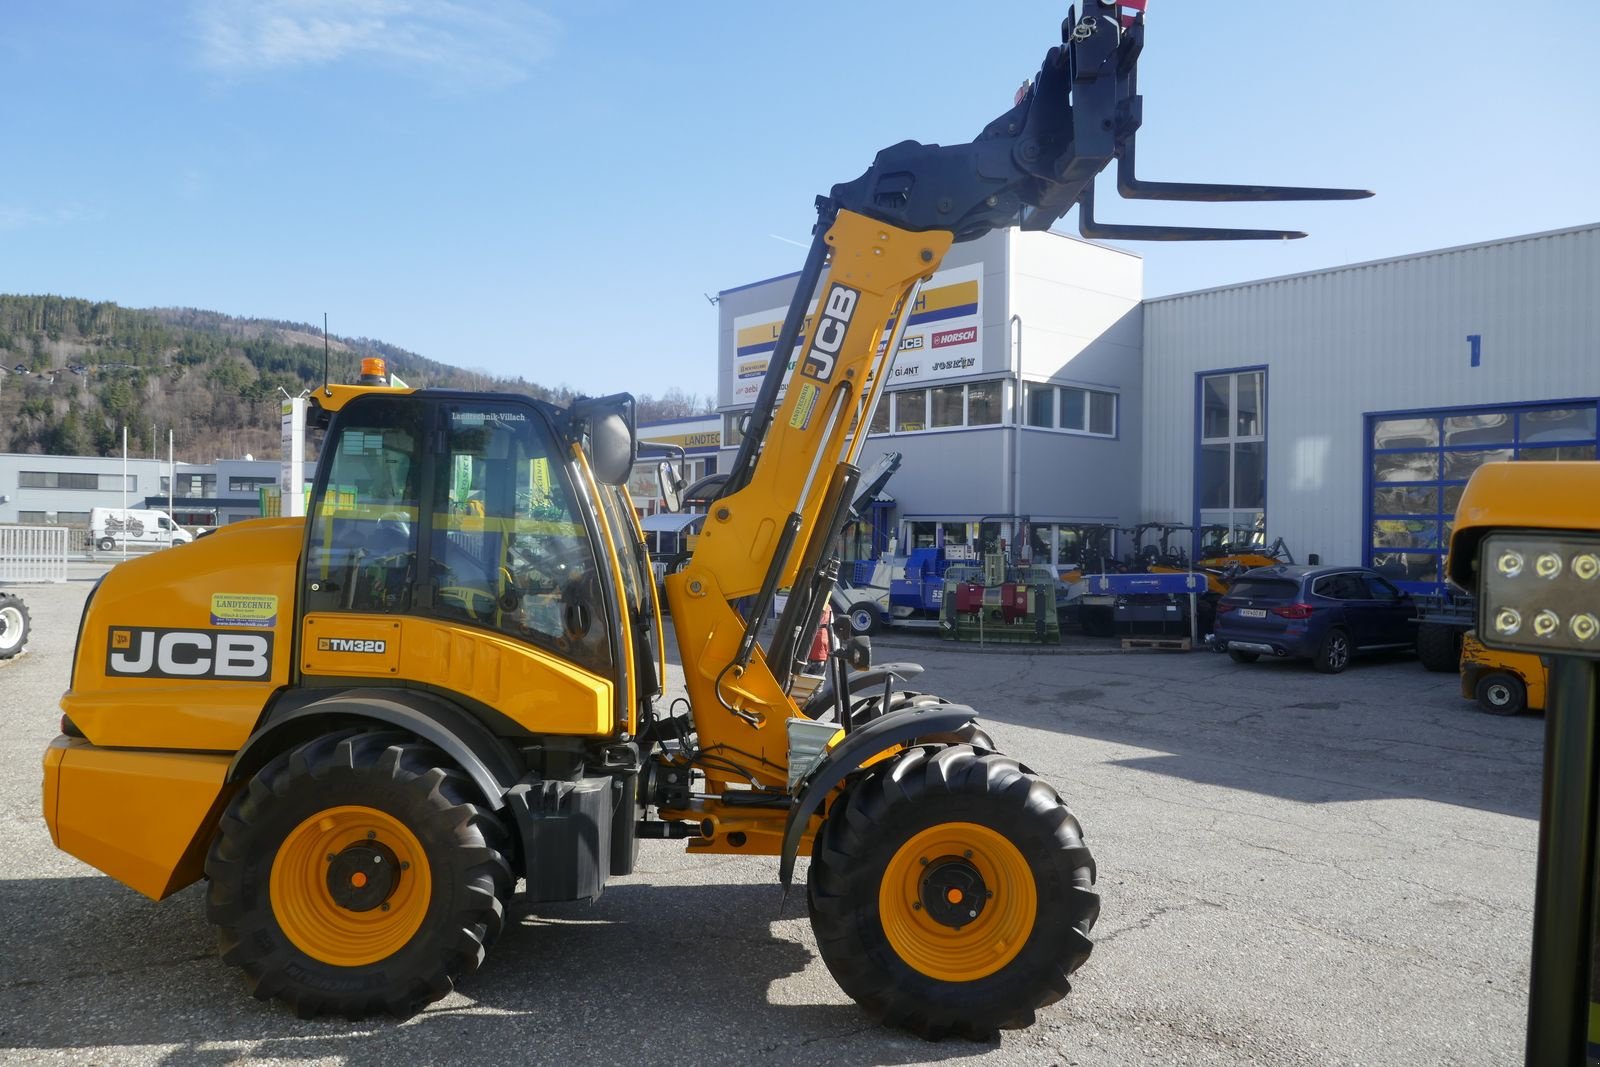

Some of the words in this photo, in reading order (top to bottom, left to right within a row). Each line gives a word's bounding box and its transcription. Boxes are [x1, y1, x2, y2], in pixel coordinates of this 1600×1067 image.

[810, 286, 857, 380] JCB
[940, 330, 975, 344] HORSCH
[1466, 335, 1481, 367] 1
[932, 357, 976, 371] JOSKIN
[790, 384, 810, 426] LANDTECHNIK
[684, 433, 720, 446] LANDTEC
[216, 600, 272, 609] LANDTECHNIK
[331, 639, 385, 652] TM320
[111, 631, 268, 677] JCB
